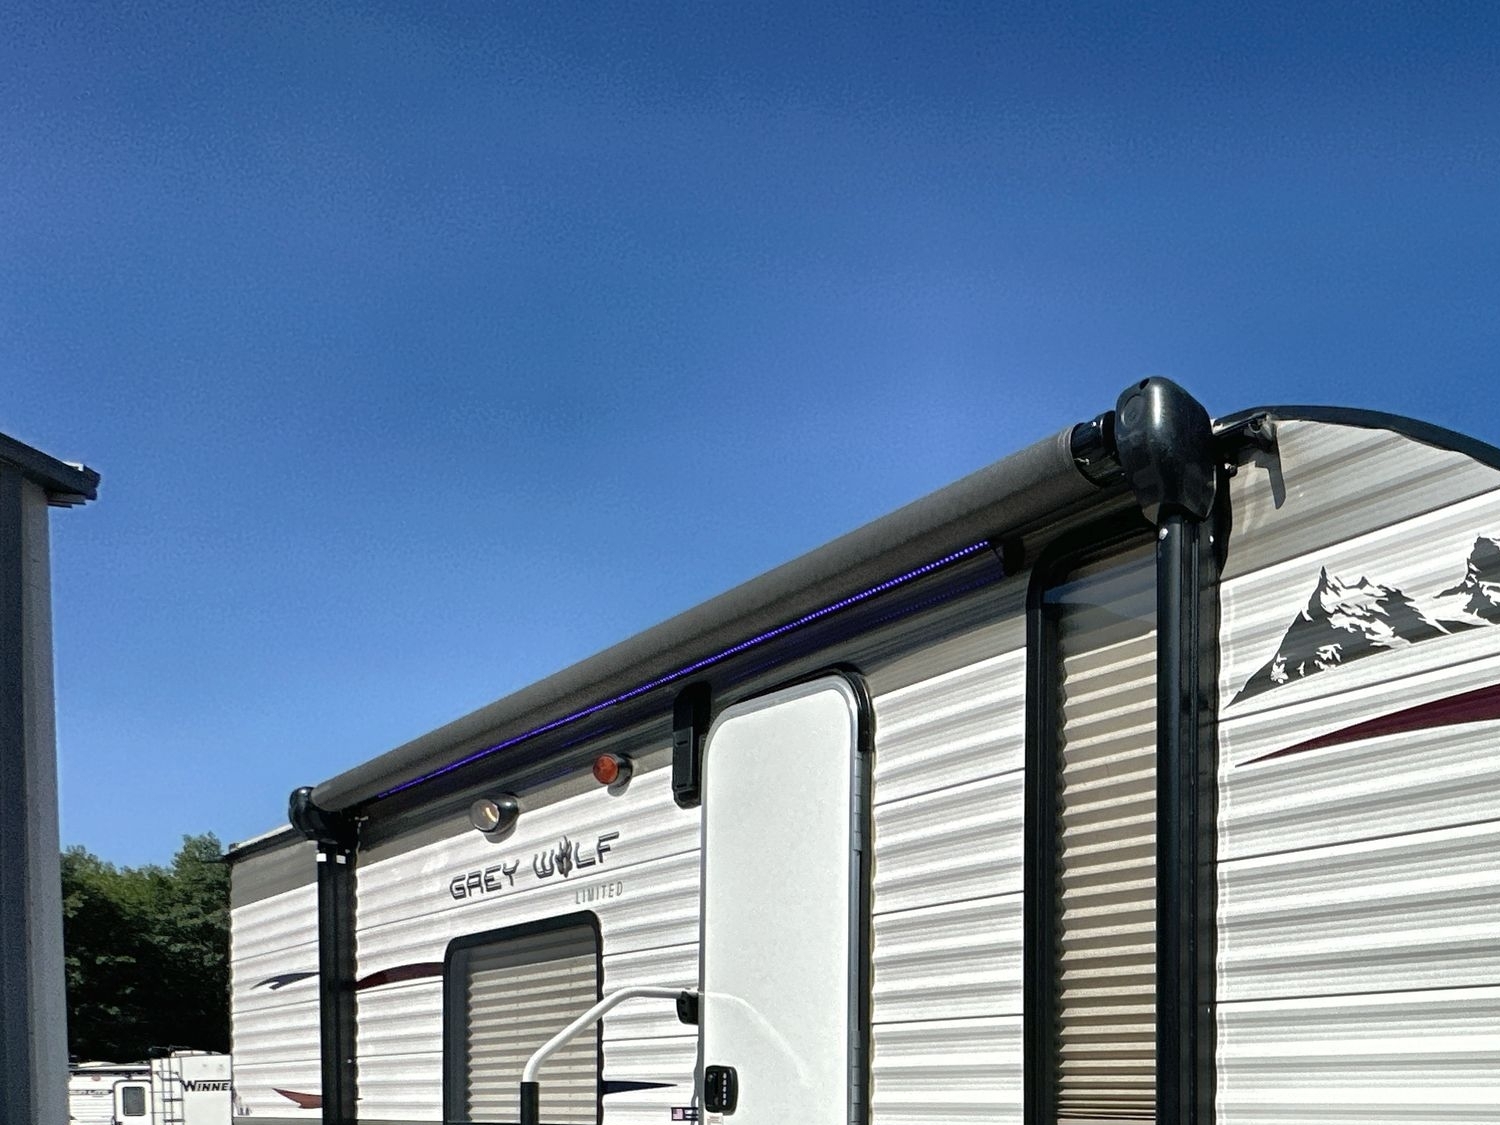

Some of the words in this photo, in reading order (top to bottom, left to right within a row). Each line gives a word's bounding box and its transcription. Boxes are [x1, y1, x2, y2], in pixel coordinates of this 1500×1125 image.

[449, 859, 520, 900] GREY
[575, 881, 624, 905] LIMITED
[180, 1079, 232, 1092] WINNE
